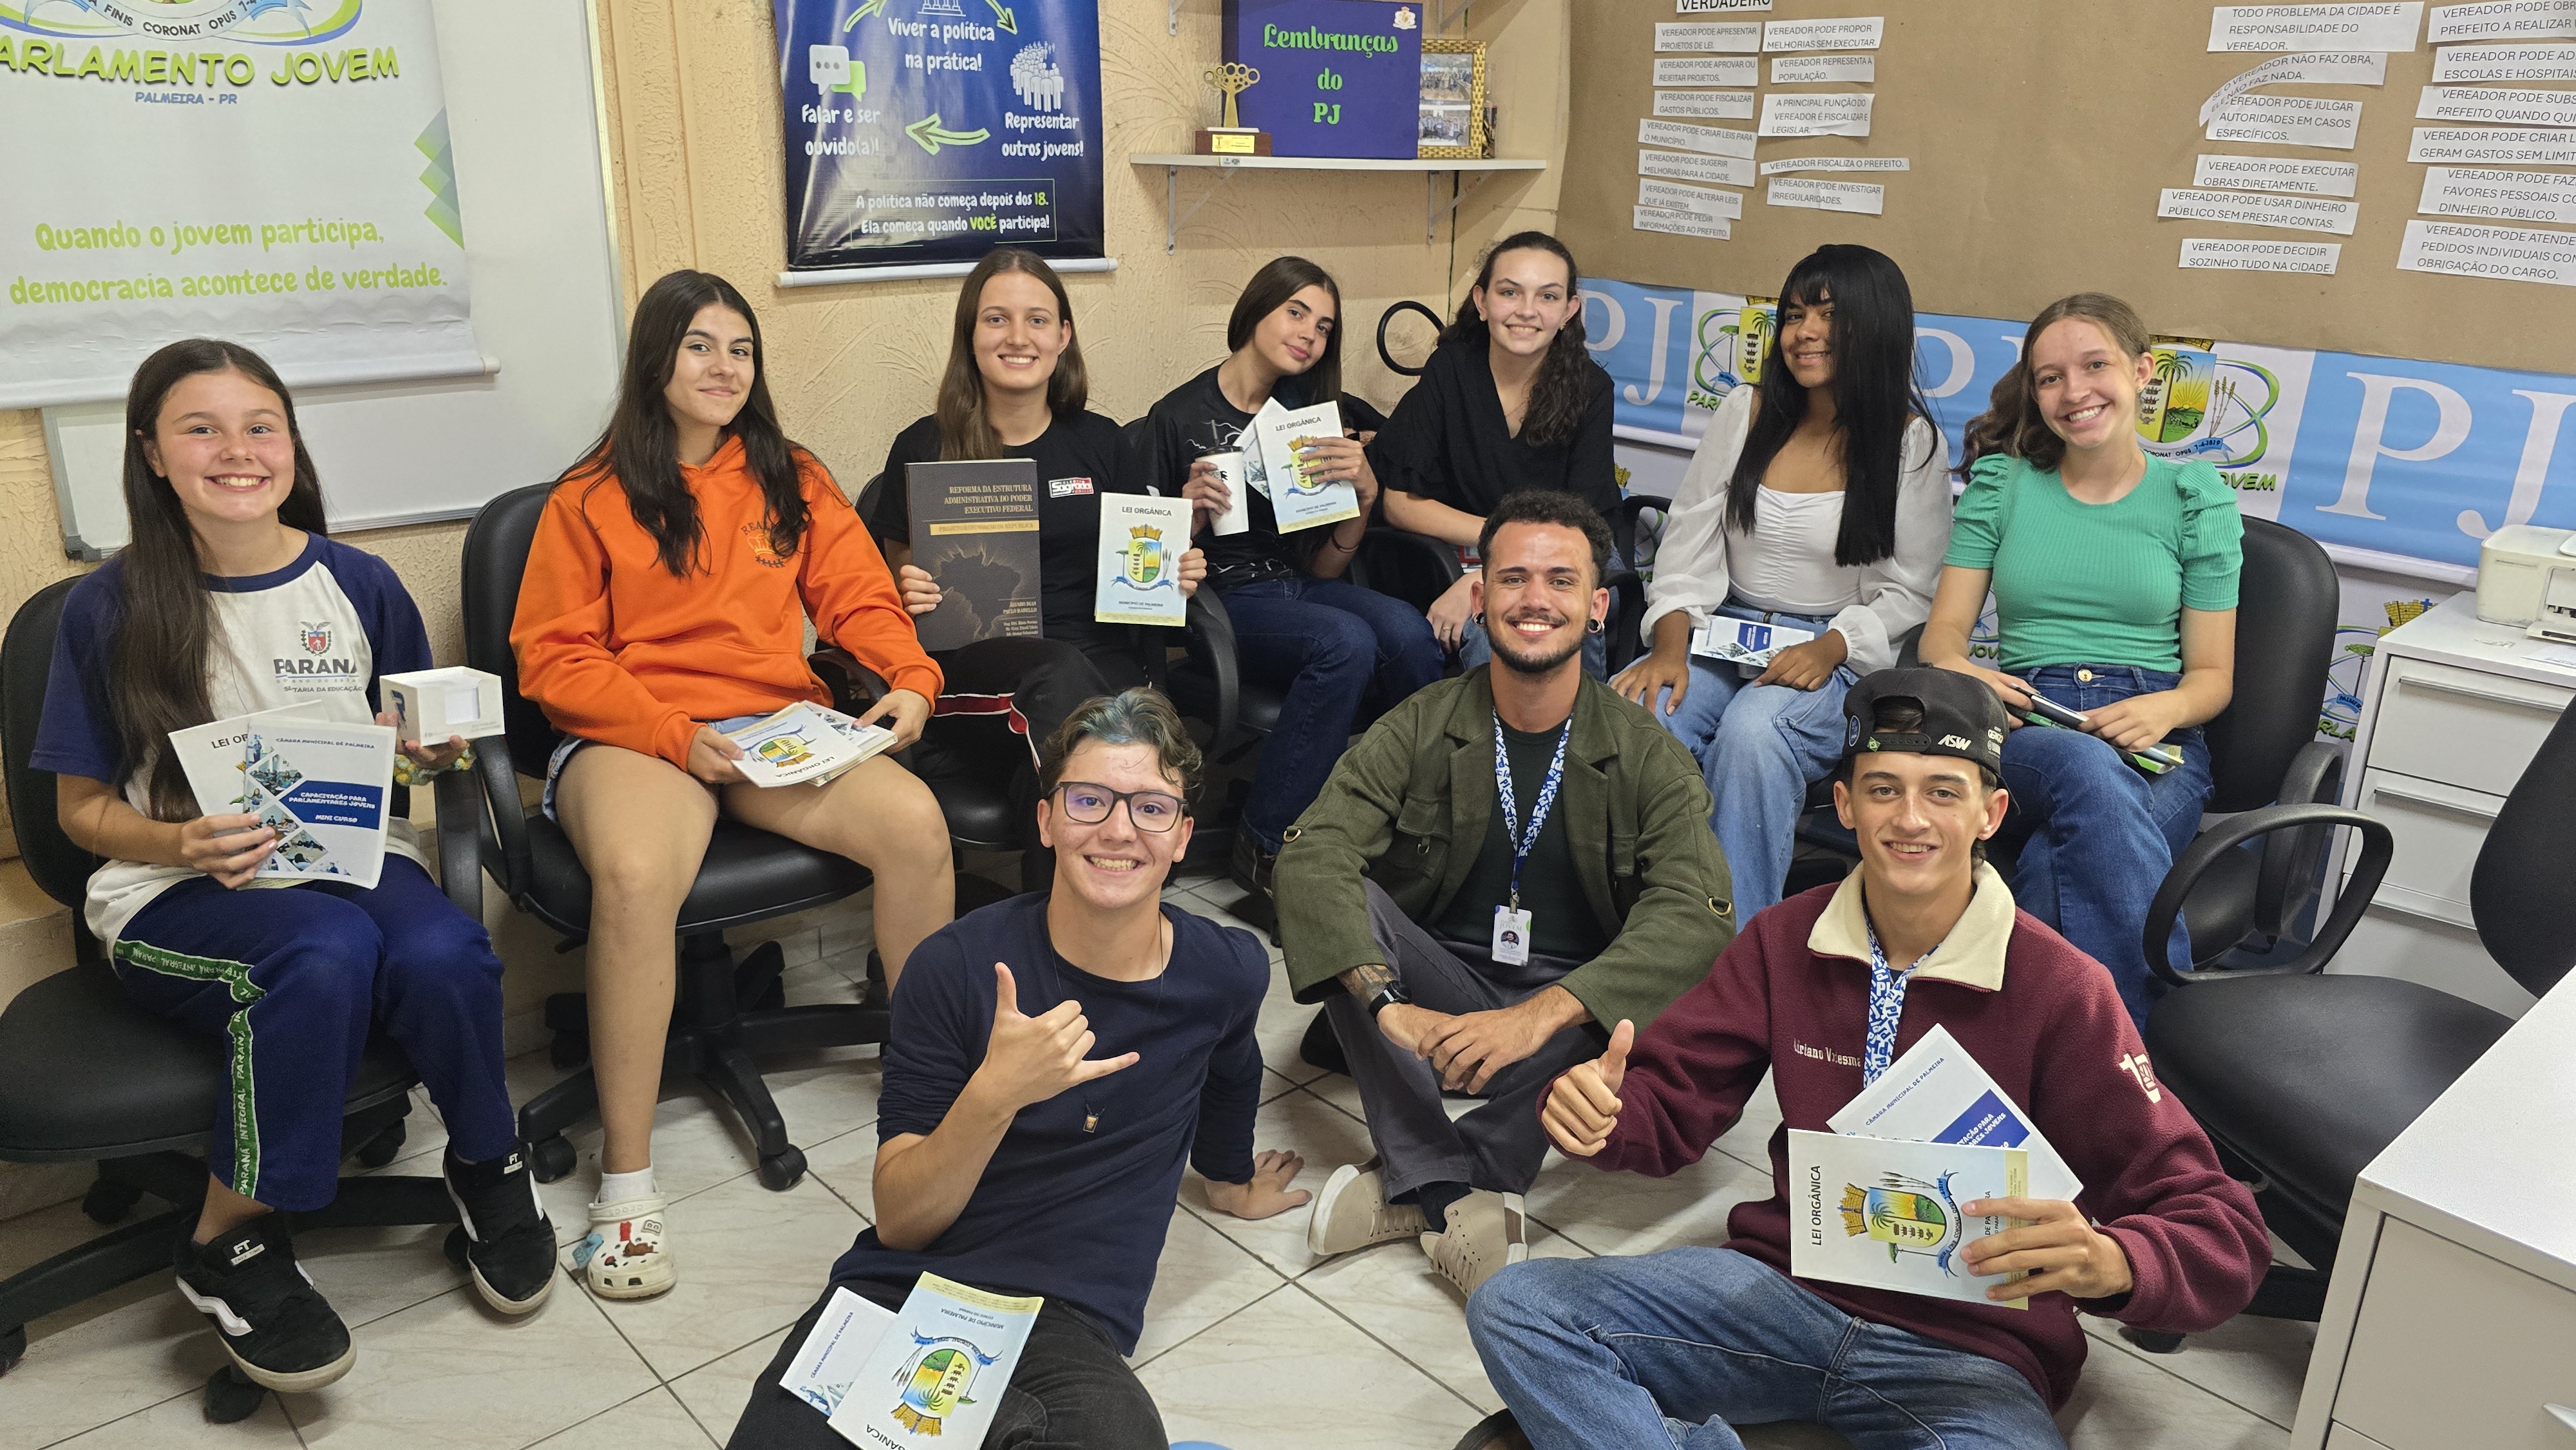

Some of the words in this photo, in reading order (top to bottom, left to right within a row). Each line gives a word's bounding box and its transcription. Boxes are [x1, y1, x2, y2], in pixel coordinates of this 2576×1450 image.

[2233, 9, 2263, 17] TODO
[2266, 8, 2326, 17] PROBLEMA
[2329, 7, 2344, 15] DA
[2347, 6, 2391, 15] CIDADE
[2394, 3, 2401, 14] É
[104, 4, 133, 27] FINIS
[143, 22, 201, 35] CORONAT
[209, 10, 238, 30] OPUS
[2441, 23, 2499, 35] PREFEITO
[2503, 22, 2511, 31] A
[2515, 19, 2571, 30] REALIZAR
[888, 17, 927, 37] Viver
[931, 24, 940, 38] a
[943, 21, 994, 44] política
[1716, 27, 1757, 35] APRESENTAR
[1768, 26, 1813, 35] VEREADOR
[2230, 24, 2339, 34] RESPONSABILIDADE
[2342, 24, 2358, 32] DO
[1264, 23, 1399, 58] Lembranças
[1767, 41, 1815, 49] MELHORIAS
[2226, 42, 2287, 50] VEREADOR.
[0, 35, 254, 85] ARLAMENTO
[270, 46, 399, 86] JOVEM
[905, 53, 923, 69] na
[927, 52, 982, 75] prática!
[1317, 68, 1343, 91] do
[2212, 91, 2222, 101] SE
[2233, 58, 2288, 84] VEREADOR
[2291, 53, 2316, 64] NÃO
[2319, 55, 2338, 63] FAZ
[2342, 55, 2374, 65] OBRA,
[135, 92, 204, 104] PALMEIRA
[220, 93, 237, 104] PR
[802, 104, 840, 124] Falar
[844, 109, 853, 124] e
[857, 106, 880, 124] ser
[1005, 112, 1079, 131] Representar
[1313, 102, 1341, 125] PJ
[2219, 112, 2295, 125] AUTORIDADES
[2297, 116, 2312, 126] EM
[2315, 118, 2351, 128] CASOS
[2216, 128, 2289, 140] ESPECÍFICOS.
[805, 138, 880, 156] ouvido(a)!
[1001, 144, 1041, 157] outros
[1041, 140, 1084, 161] jovens!
[1770, 160, 1815, 170] VEREADOR
[2209, 162, 2266, 172] VEREADOR
[2269, 164, 2299, 174] PODE
[2302, 166, 2355, 177] EXECUTAR
[1774, 179, 1814, 189] VEREADOR
[1816, 182, 1836, 191] PODE
[1838, 184, 1880, 194] INVESTIGAR
[2204, 178, 2239, 187] OBRAS
[2242, 179, 2318, 191] DIRETAMENTE.
[857, 196, 864, 209] A
[868, 193, 911, 211] política
[914, 193, 935, 209] não
[938, 195, 977, 212] começa
[980, 193, 1013, 211] depois
[1015, 192, 1032, 206] dos
[1034, 192, 1048, 206] 18.
[2172, 191, 2230, 203] VEREADOR
[2231, 195, 2262, 205] PODE
[2264, 197, 2292, 208] USAR
[2295, 200, 2347, 212] DINHEIRO
[2168, 205, 2215, 217] PÚBLICO
[2217, 210, 2240, 219] SEM
[2242, 212, 2287, 223] PRESTAR
[2290, 216, 2334, 229] CONTAS.
[2439, 203, 2498, 216] DINHEIRO
[2501, 206, 2557, 220] PÚBLICO.
[862, 218, 880, 234] Ela
[883, 221, 925, 238] começa
[928, 218, 967, 238] quando
[970, 214, 997, 231] VOCÊ
[999, 214, 1050, 234] participa!
[35, 220, 140, 252] Quando
[149, 223, 165, 247] o
[171, 220, 252, 255] jovem
[261, 218, 384, 252] participa,
[2189, 258, 2238, 268] SOZINHO
[2241, 259, 2270, 269] TUDO
[2273, 261, 2287, 270] NA
[2290, 262, 2333, 273] CIDADE.
[2418, 258, 2487, 273] OBRIGAÇÃO
[2490, 265, 2508, 274] DO
[2512, 267, 2559, 279] CARGO.
[9, 272, 173, 305] democracia
[181, 269, 298, 297] acontece
[305, 265, 335, 291] de
[342, 261, 448, 290] verdade.
[1287, 417, 1321, 429] ORGÂNICA
[993, 484, 1032, 493] ESTRUTURA
[944, 496, 999, 504] ADMINISTRATIVA
[965, 505, 1001, 514] EXECUTIVO
[1135, 507, 1171, 516] ORGÂNICA
[211, 737, 229, 749] LEI
[1938, 735, 1971, 750] ASW
[1887, 1086, 1913, 1109] MUNICIPAL
[1920, 1057, 1945, 1080] PALMEIRA
[239, 1088, 249, 1140] INTEGRAL
[1978, 1113, 1994, 1129] PARA
[1984, 1112, 2006, 1135] JOVENS
[1811, 1165, 1821, 1224] ORGÂNICA
[1812, 1227, 1822, 1246] LEI
[234, 1240, 250, 1254] FT
[941, 1308, 967, 1319] PALMEIRA
